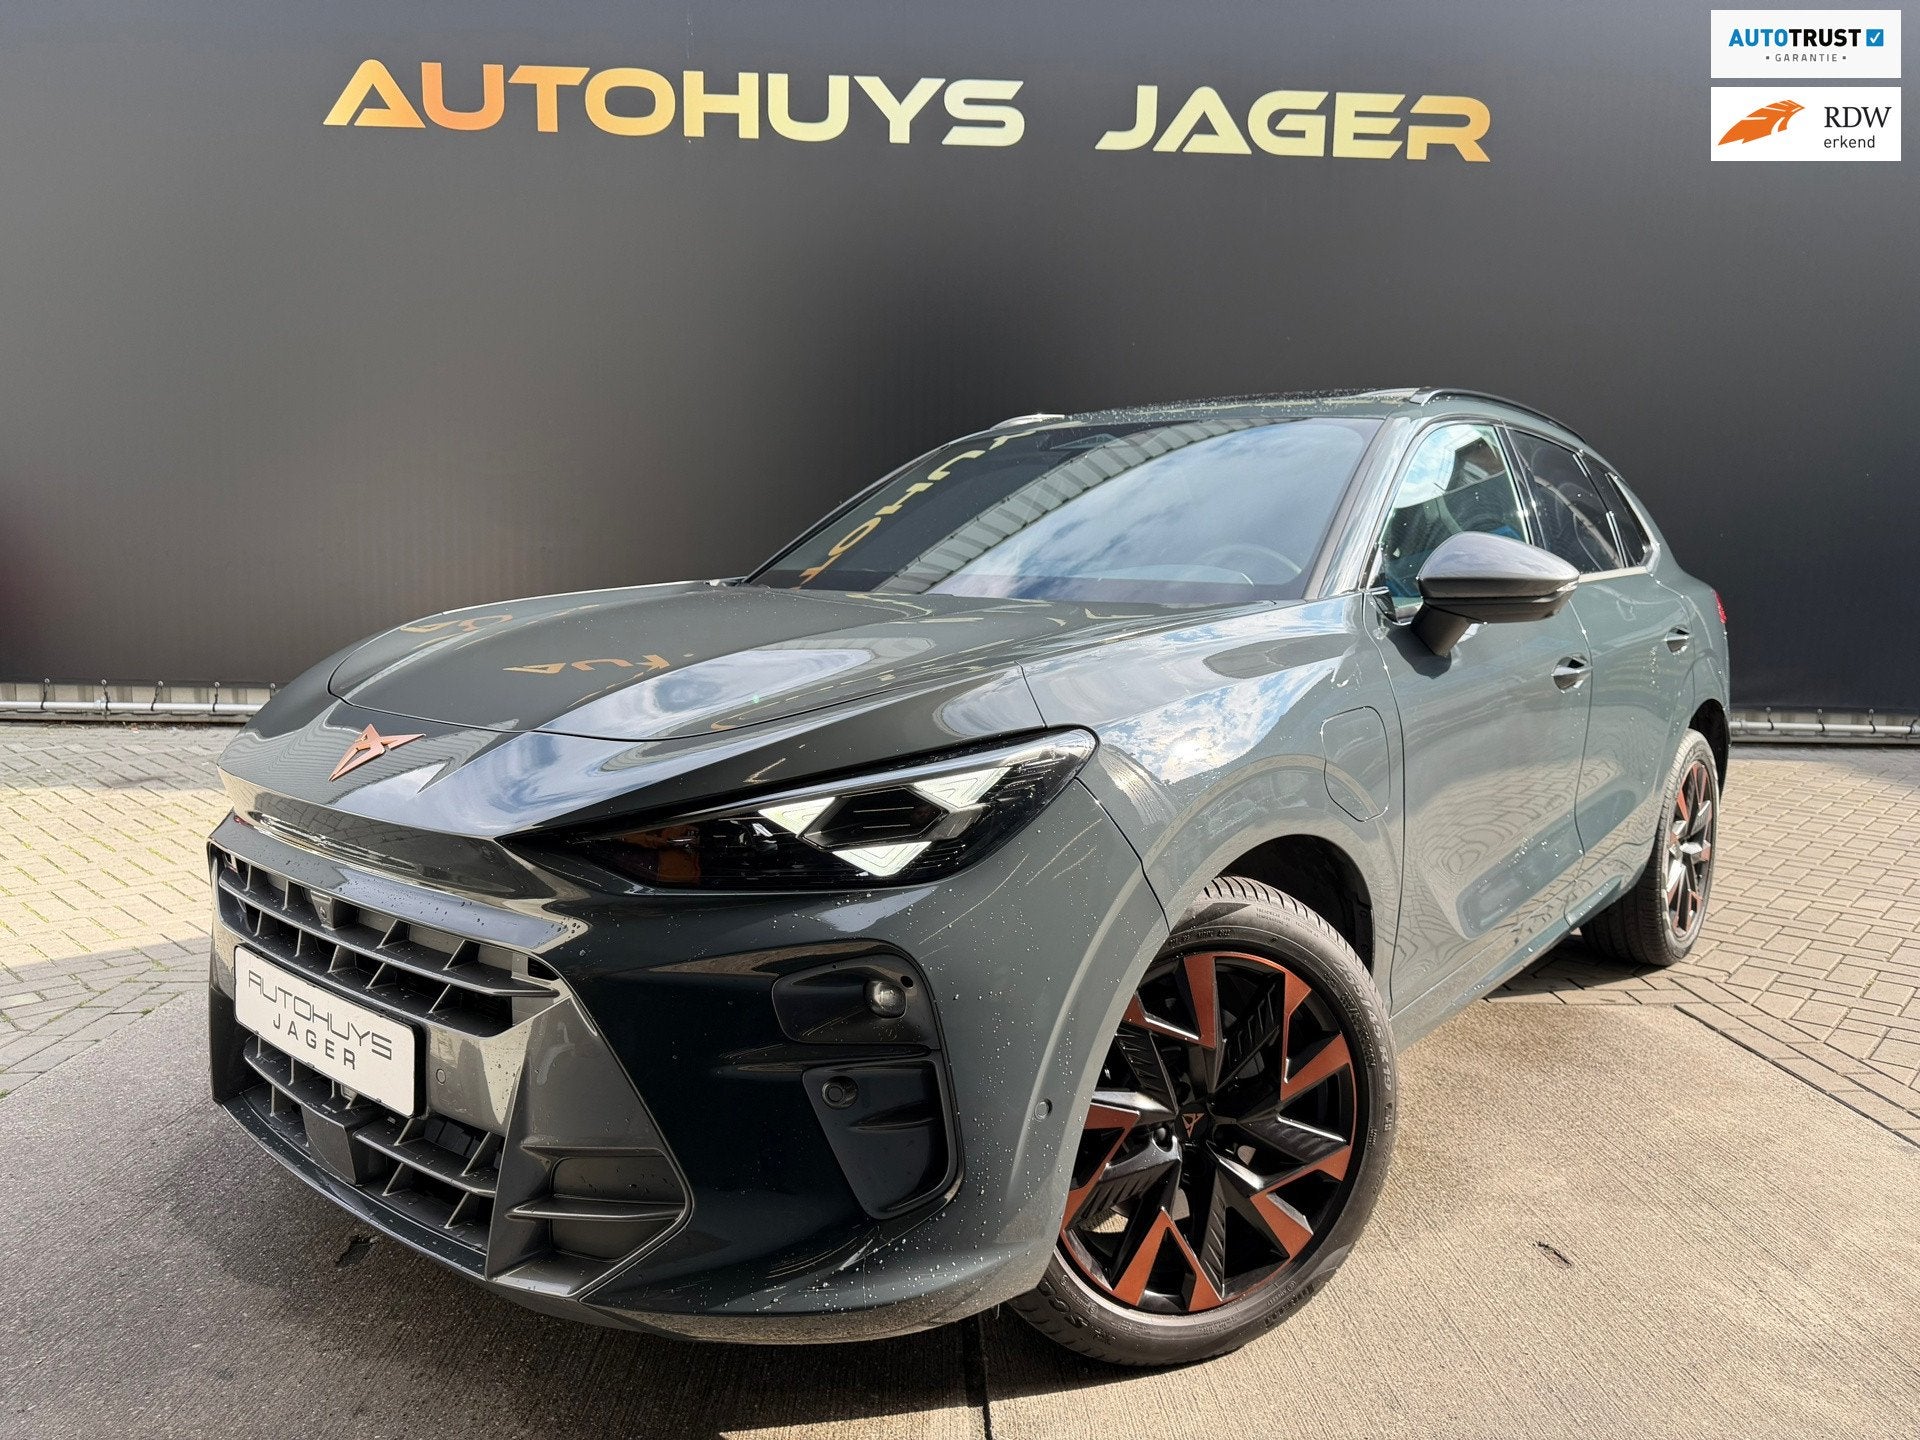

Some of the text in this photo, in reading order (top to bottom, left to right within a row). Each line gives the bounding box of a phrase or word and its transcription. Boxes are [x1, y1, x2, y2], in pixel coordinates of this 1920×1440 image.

[323, 59, 1491, 162] AUTOHUYS JAGER
[248, 969, 392, 1061] AUTOHUYS
[272, 1013, 356, 1071] JAGER
